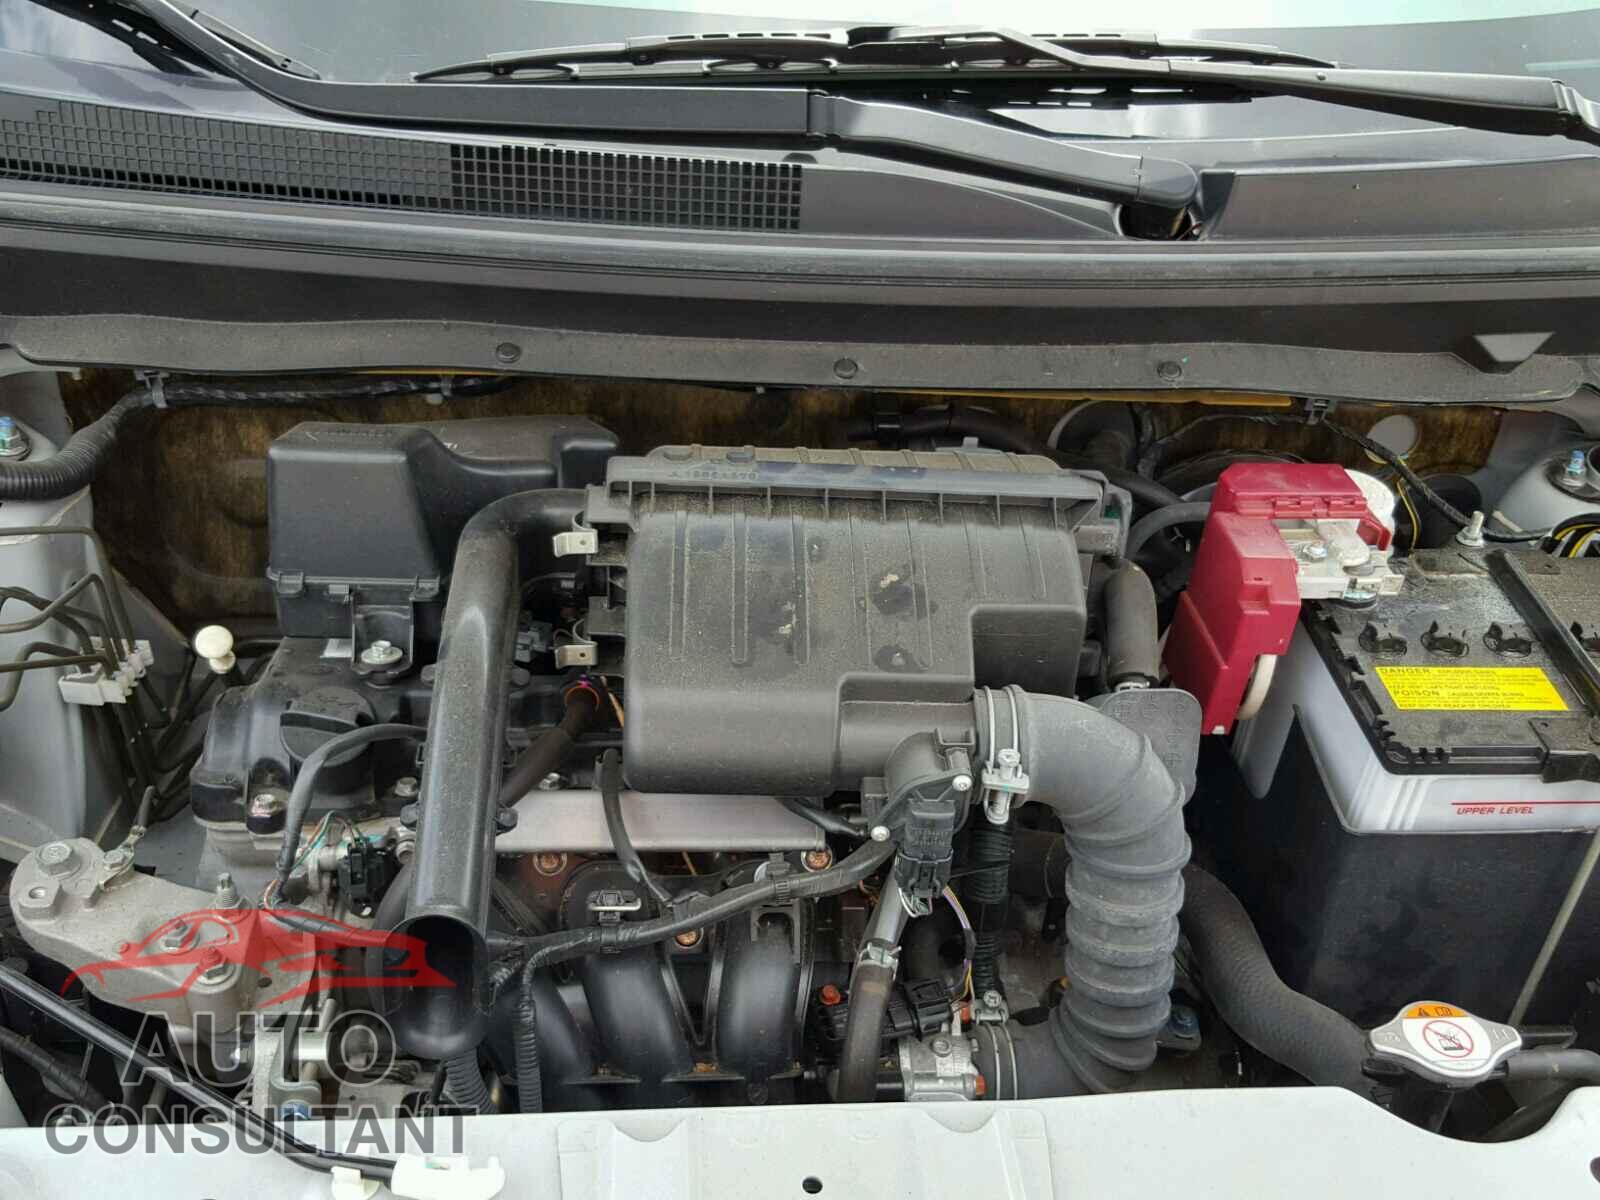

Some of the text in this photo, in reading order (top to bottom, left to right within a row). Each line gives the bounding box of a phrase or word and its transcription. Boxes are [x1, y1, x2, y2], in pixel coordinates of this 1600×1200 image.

[1393, 689, 1440, 697] POISON
[1456, 805, 1536, 815] UPPER LEVEL
